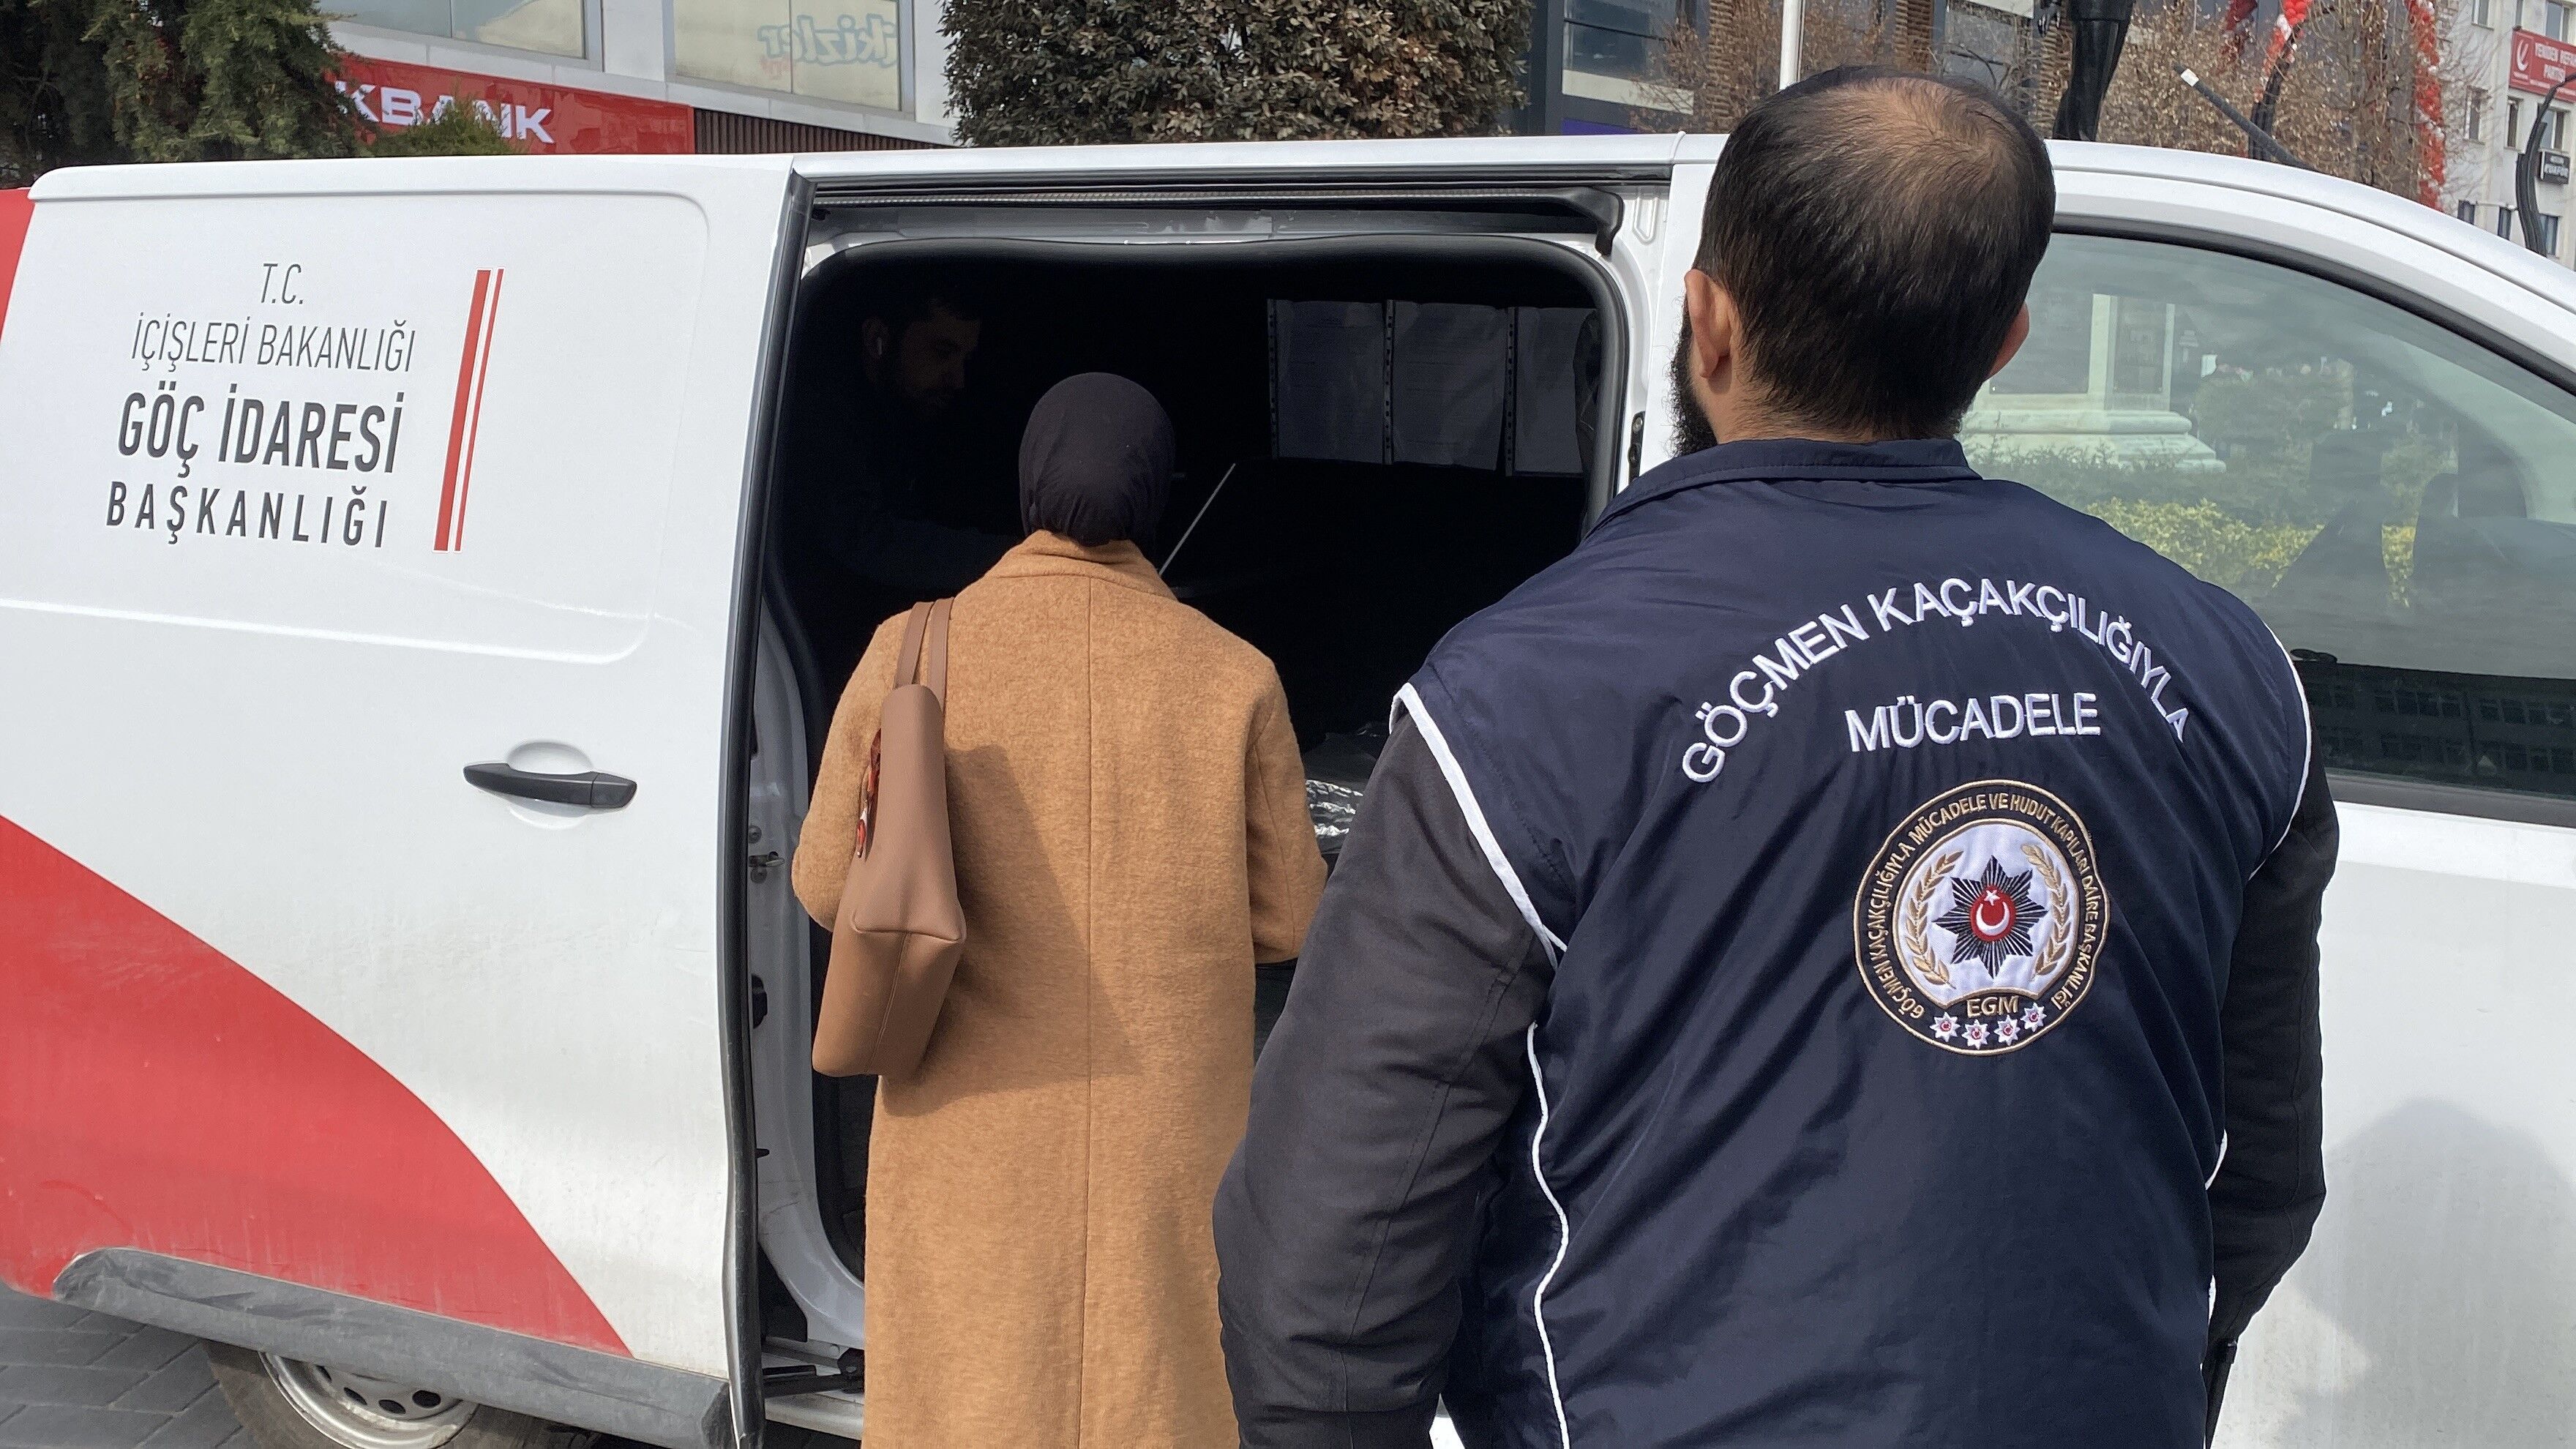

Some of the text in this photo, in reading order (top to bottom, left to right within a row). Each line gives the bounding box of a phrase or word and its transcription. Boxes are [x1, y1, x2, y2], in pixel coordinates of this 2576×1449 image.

[261, 263, 304, 304] T.C.
[131, 311, 416, 372] İÇİŞLERİ BAKANLIĞI
[118, 380, 405, 479] GÖÇ İDARESİ
[105, 480, 388, 548] BAŞKANLIĞI
[1682, 577, 2190, 783] GÖÇMEN KAÇAKÇILIĞIYLA
[1844, 692, 2101, 752] MÜCADELE
[1908, 793, 1988, 845] MÜCADELE
[1989, 793, 2009, 810] VE
[2010, 793, 2056, 825] HUDUT
[2051, 815, 2090, 875] KAPILARI
[1867, 842, 1916, 961] KAÇAKÇILIĞIYLA
[1873, 959, 1925, 1019] GÖÇMEN
[1966, 995, 2020, 1019] EGM
